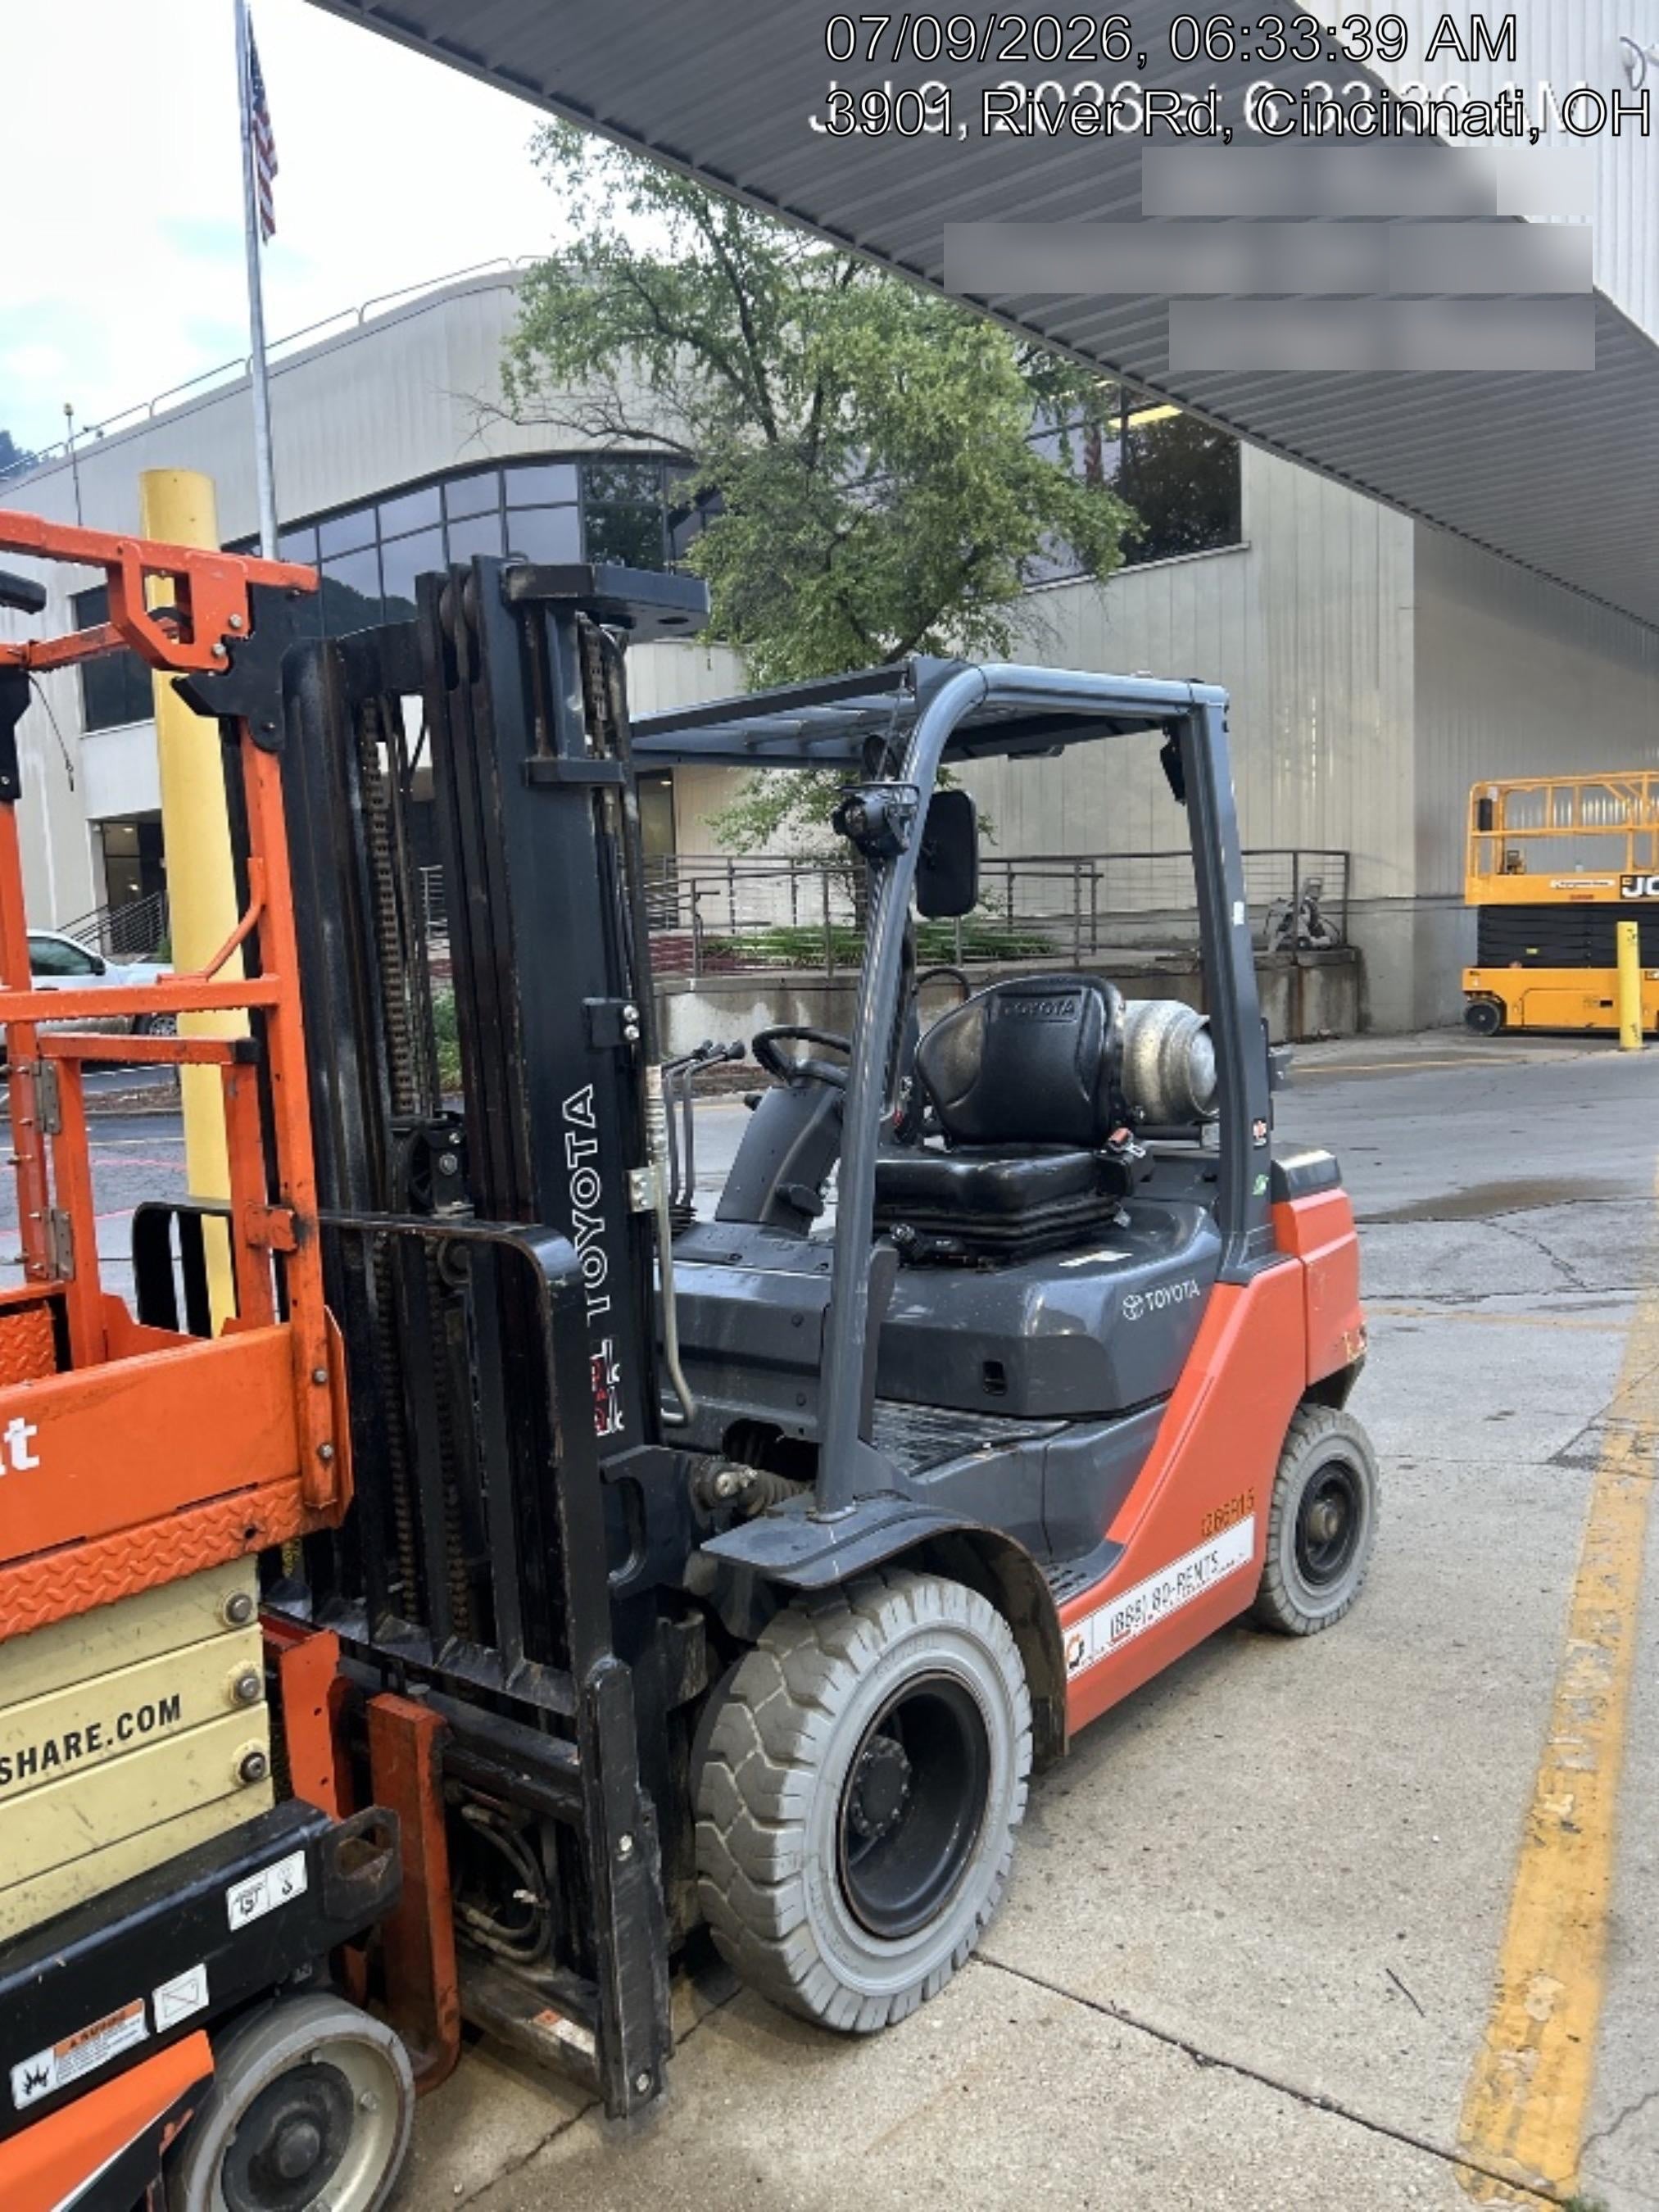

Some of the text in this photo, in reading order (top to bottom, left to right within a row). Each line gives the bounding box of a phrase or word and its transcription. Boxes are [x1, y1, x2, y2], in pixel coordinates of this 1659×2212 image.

[562, 1082, 612, 1327] TOYOTA
[1145, 1279, 1201, 1311] TOYOTA
[0, 1693, 180, 1785] SHARE.COM
